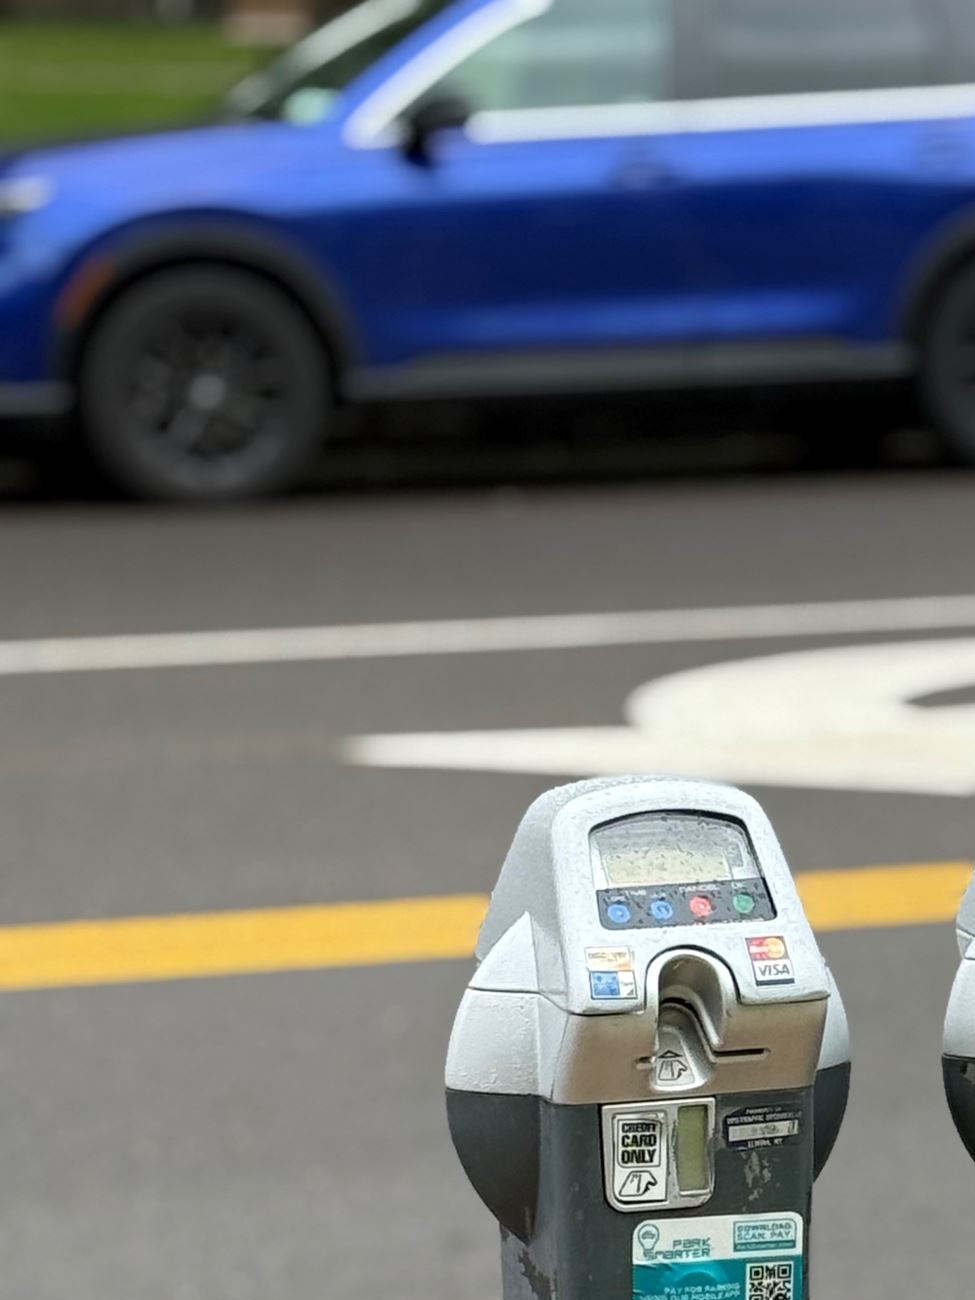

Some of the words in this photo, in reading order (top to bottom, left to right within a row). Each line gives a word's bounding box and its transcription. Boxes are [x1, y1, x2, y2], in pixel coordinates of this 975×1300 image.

[757, 963, 791, 977] VISA
[621, 1122, 657, 1133] CREDIT
[621, 1133, 657, 1148] CARD
[621, 1148, 657, 1164] ONLY
[672, 1237, 711, 1250] PARK
[643, 1247, 711, 1260] SMARTER
[663, 1286, 683, 1296] PAY
[684, 1285, 703, 1294] FOR
